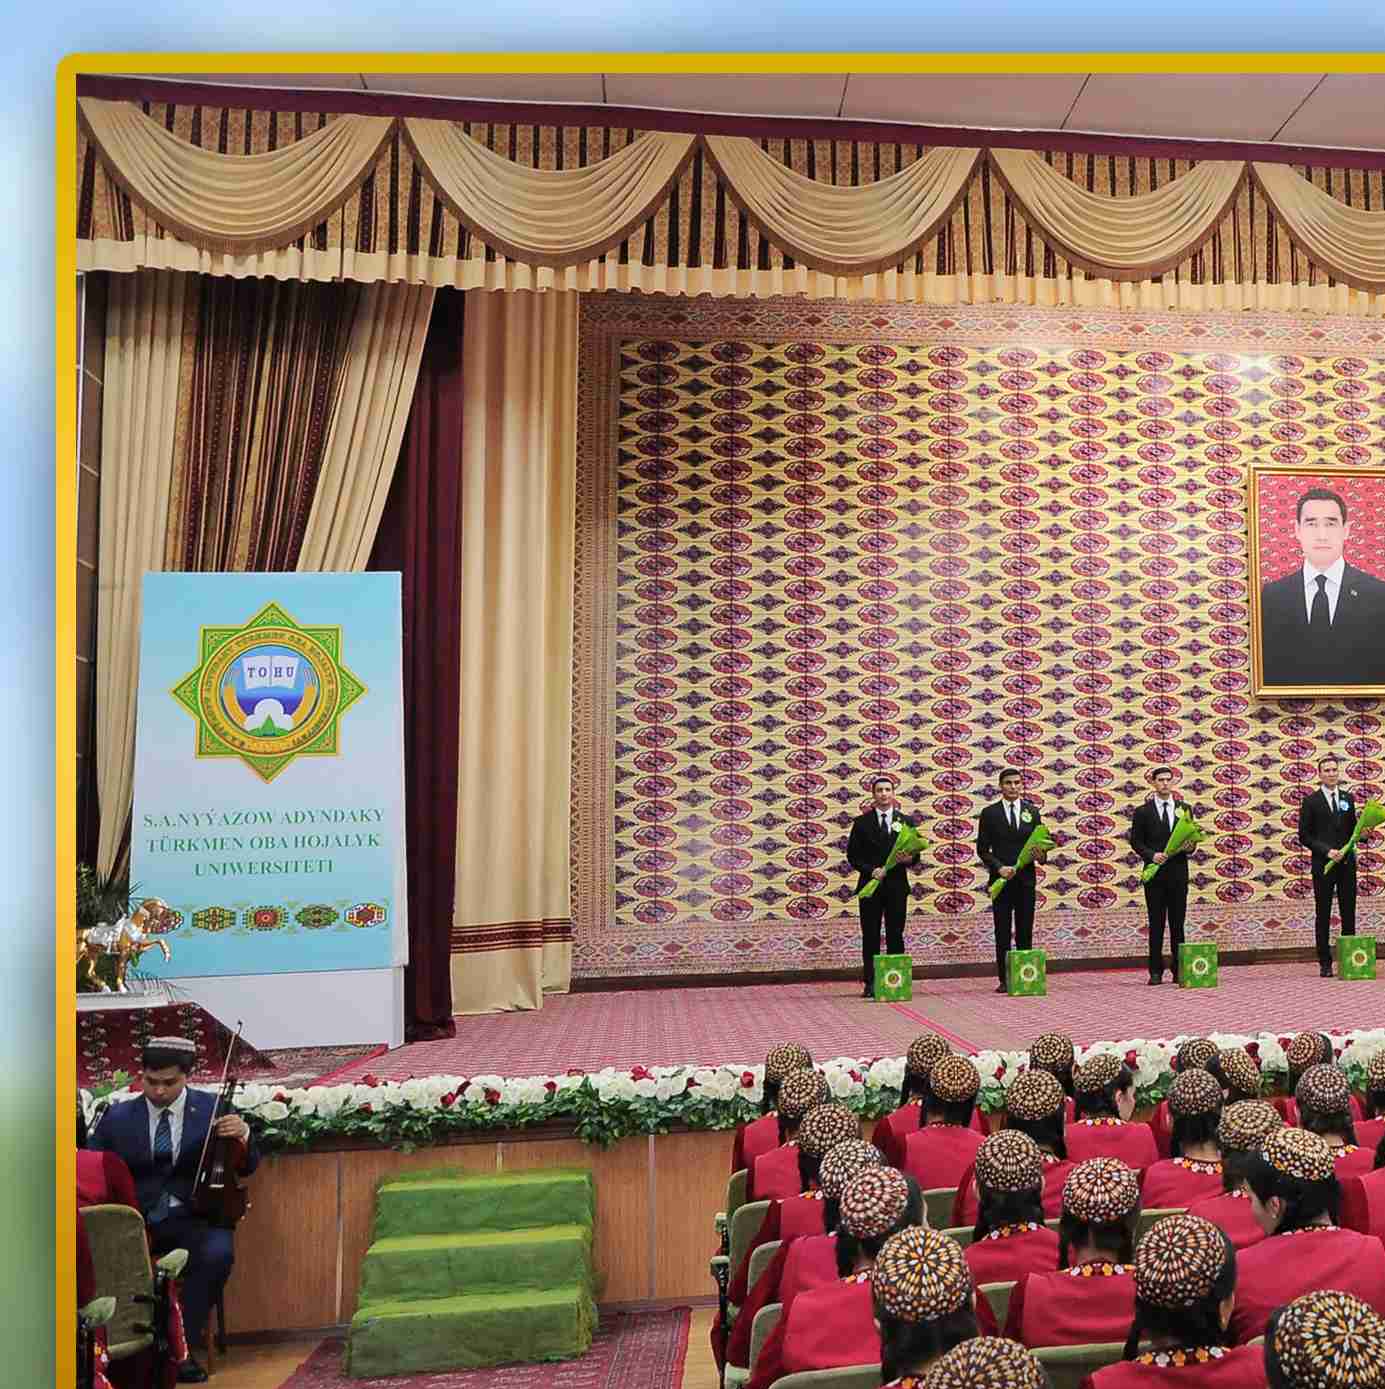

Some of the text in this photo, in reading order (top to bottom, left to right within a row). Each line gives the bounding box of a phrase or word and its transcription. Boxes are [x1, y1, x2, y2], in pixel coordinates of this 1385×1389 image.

[280, 808, 384, 825] ADYNDAKY
[146, 832, 382, 853] TÜRKMEN OBA HOJALYK
[194, 858, 334, 877] UNIWERSITETI
